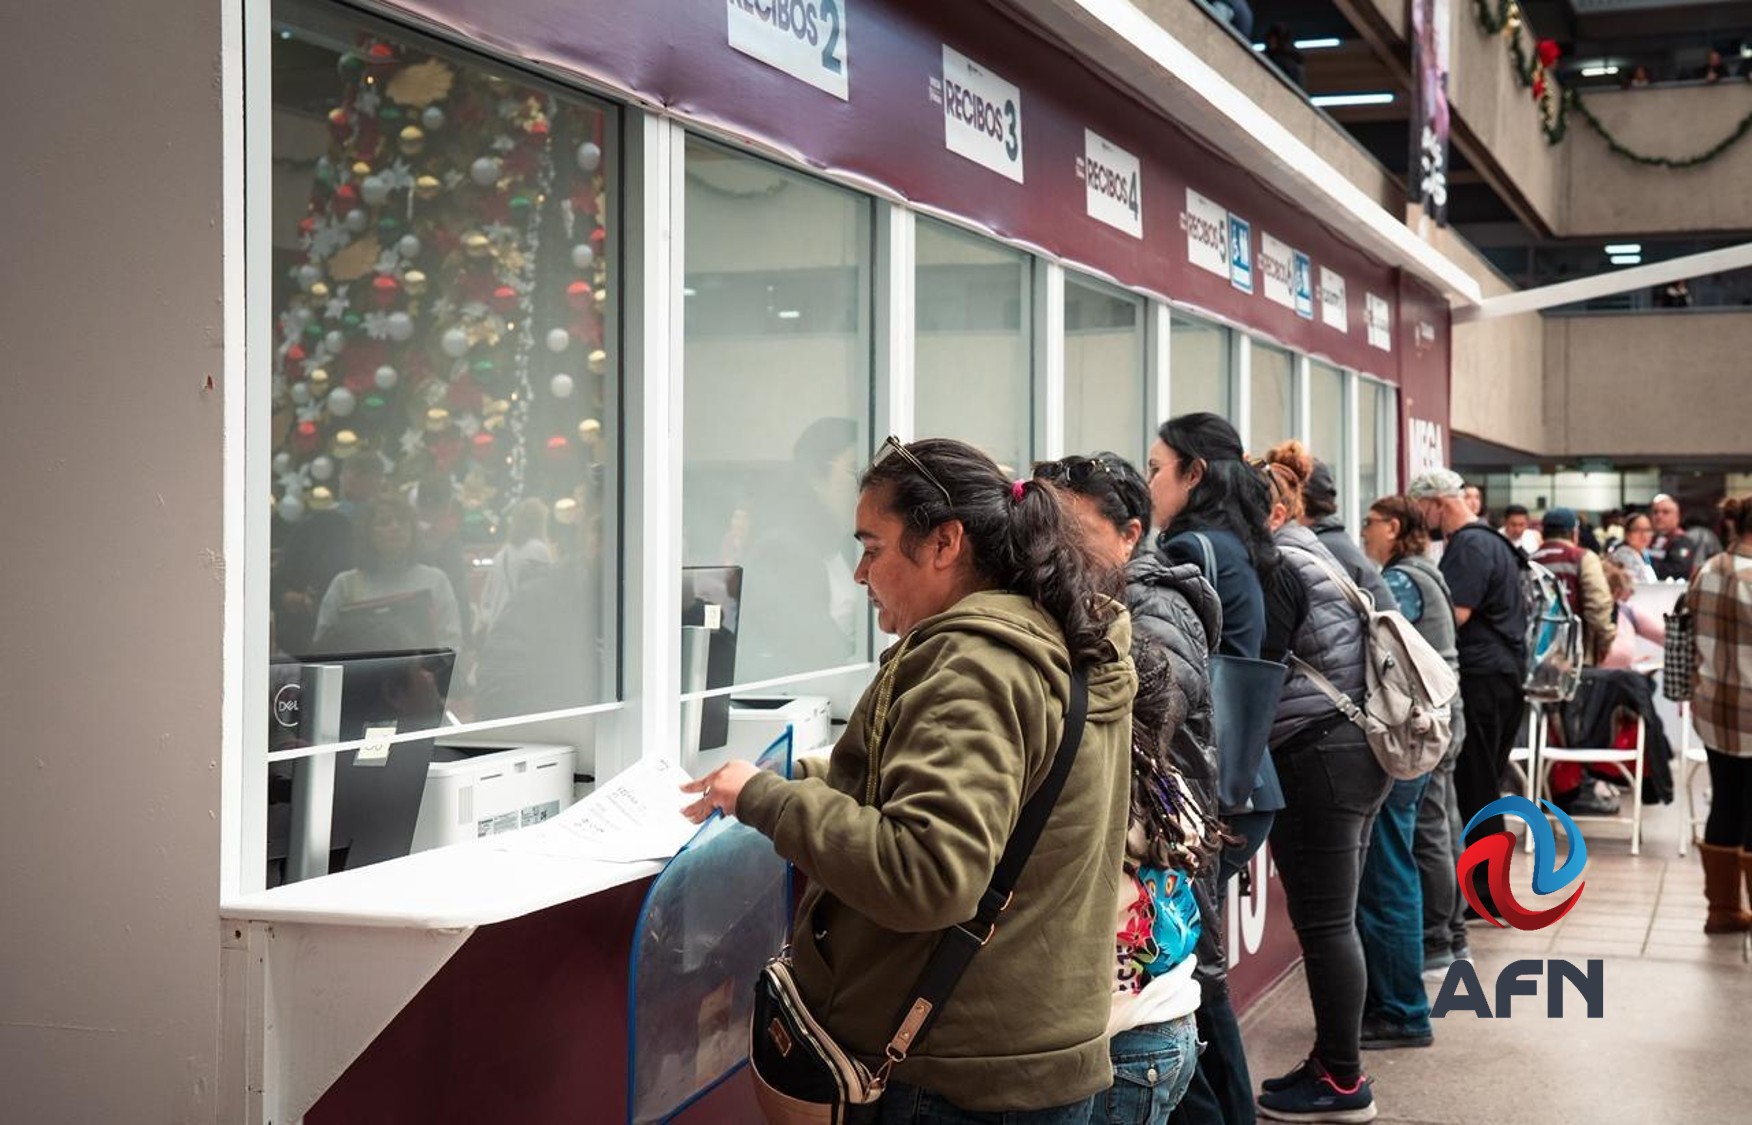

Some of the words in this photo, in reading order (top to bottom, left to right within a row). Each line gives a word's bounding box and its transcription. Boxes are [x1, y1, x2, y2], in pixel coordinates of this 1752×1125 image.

[820, 0, 842, 75] 2
[945, 79, 1003, 142] RECIBOS
[1004, 99, 1018, 162] 3
[1087, 158, 1128, 205] RECIBOS
[1128, 171, 1139, 221] 4
[1187, 211, 1218, 250] RECIBOS
[1219, 219, 1227, 264] 5
[278, 700, 300, 712] DEL
